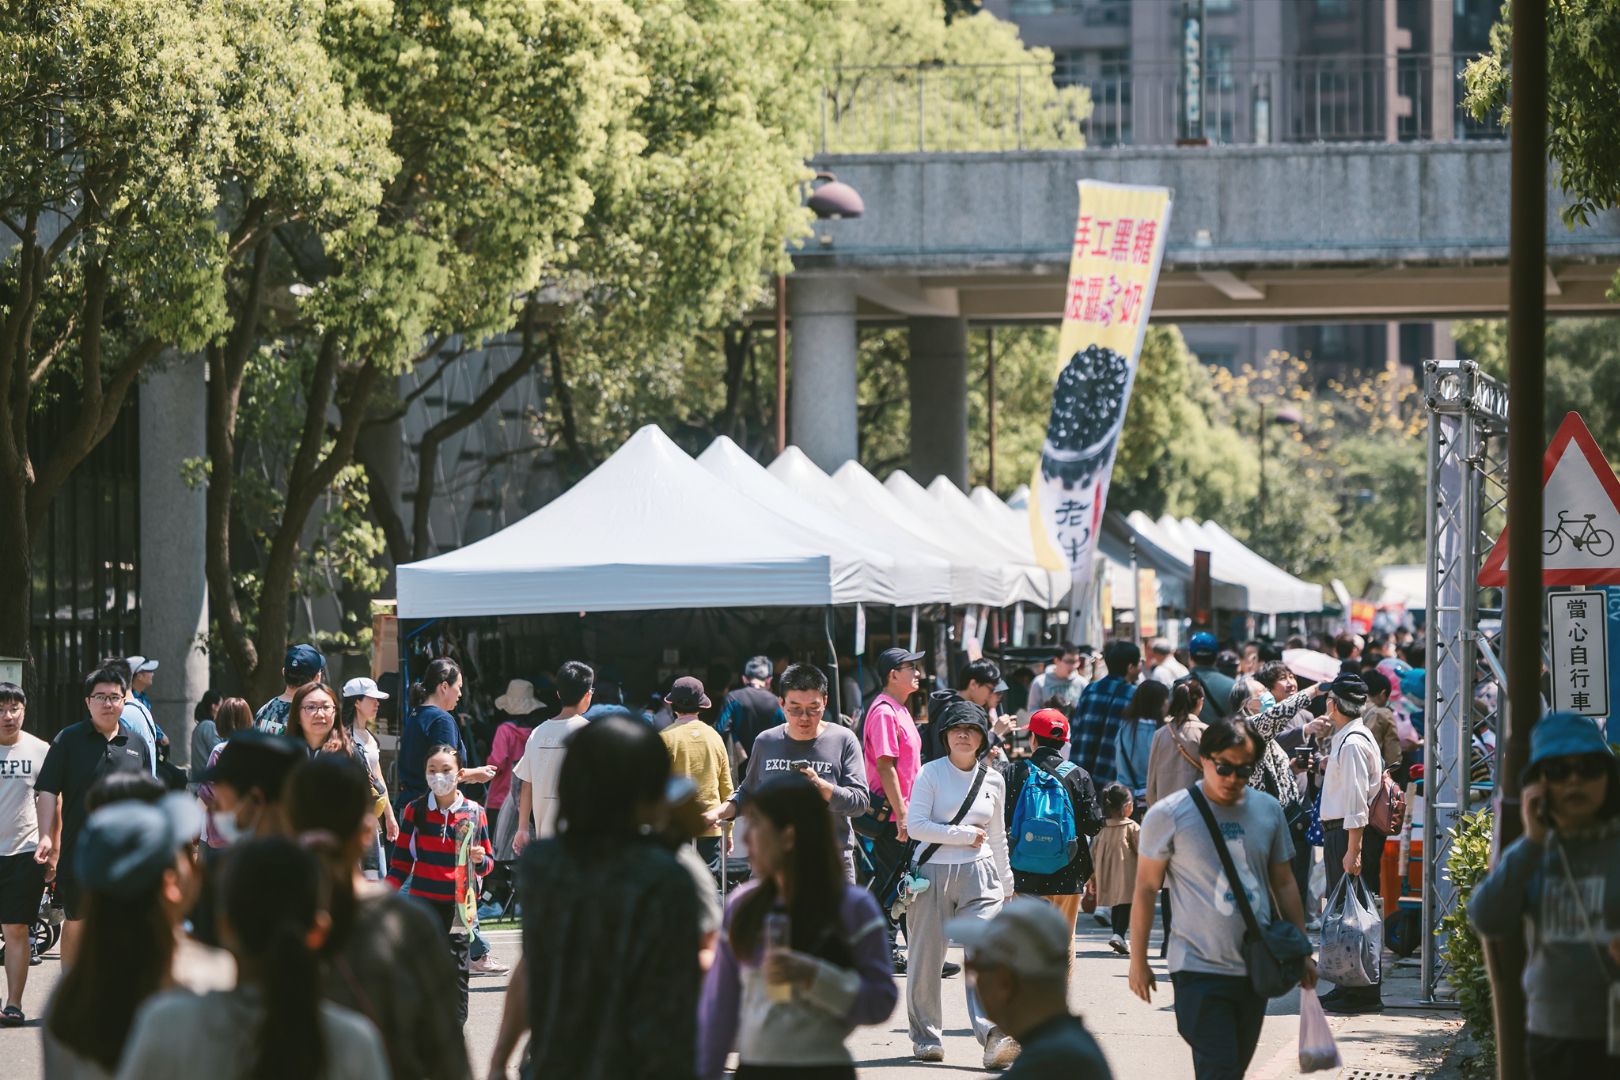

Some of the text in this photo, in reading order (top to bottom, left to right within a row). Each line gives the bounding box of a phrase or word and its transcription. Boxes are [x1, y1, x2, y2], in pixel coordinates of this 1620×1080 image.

[1074, 216, 1157, 264] 手工黑糖
[1567, 599, 1591, 711] 當心自行車
[765, 759, 833, 773] EXCLIVE
